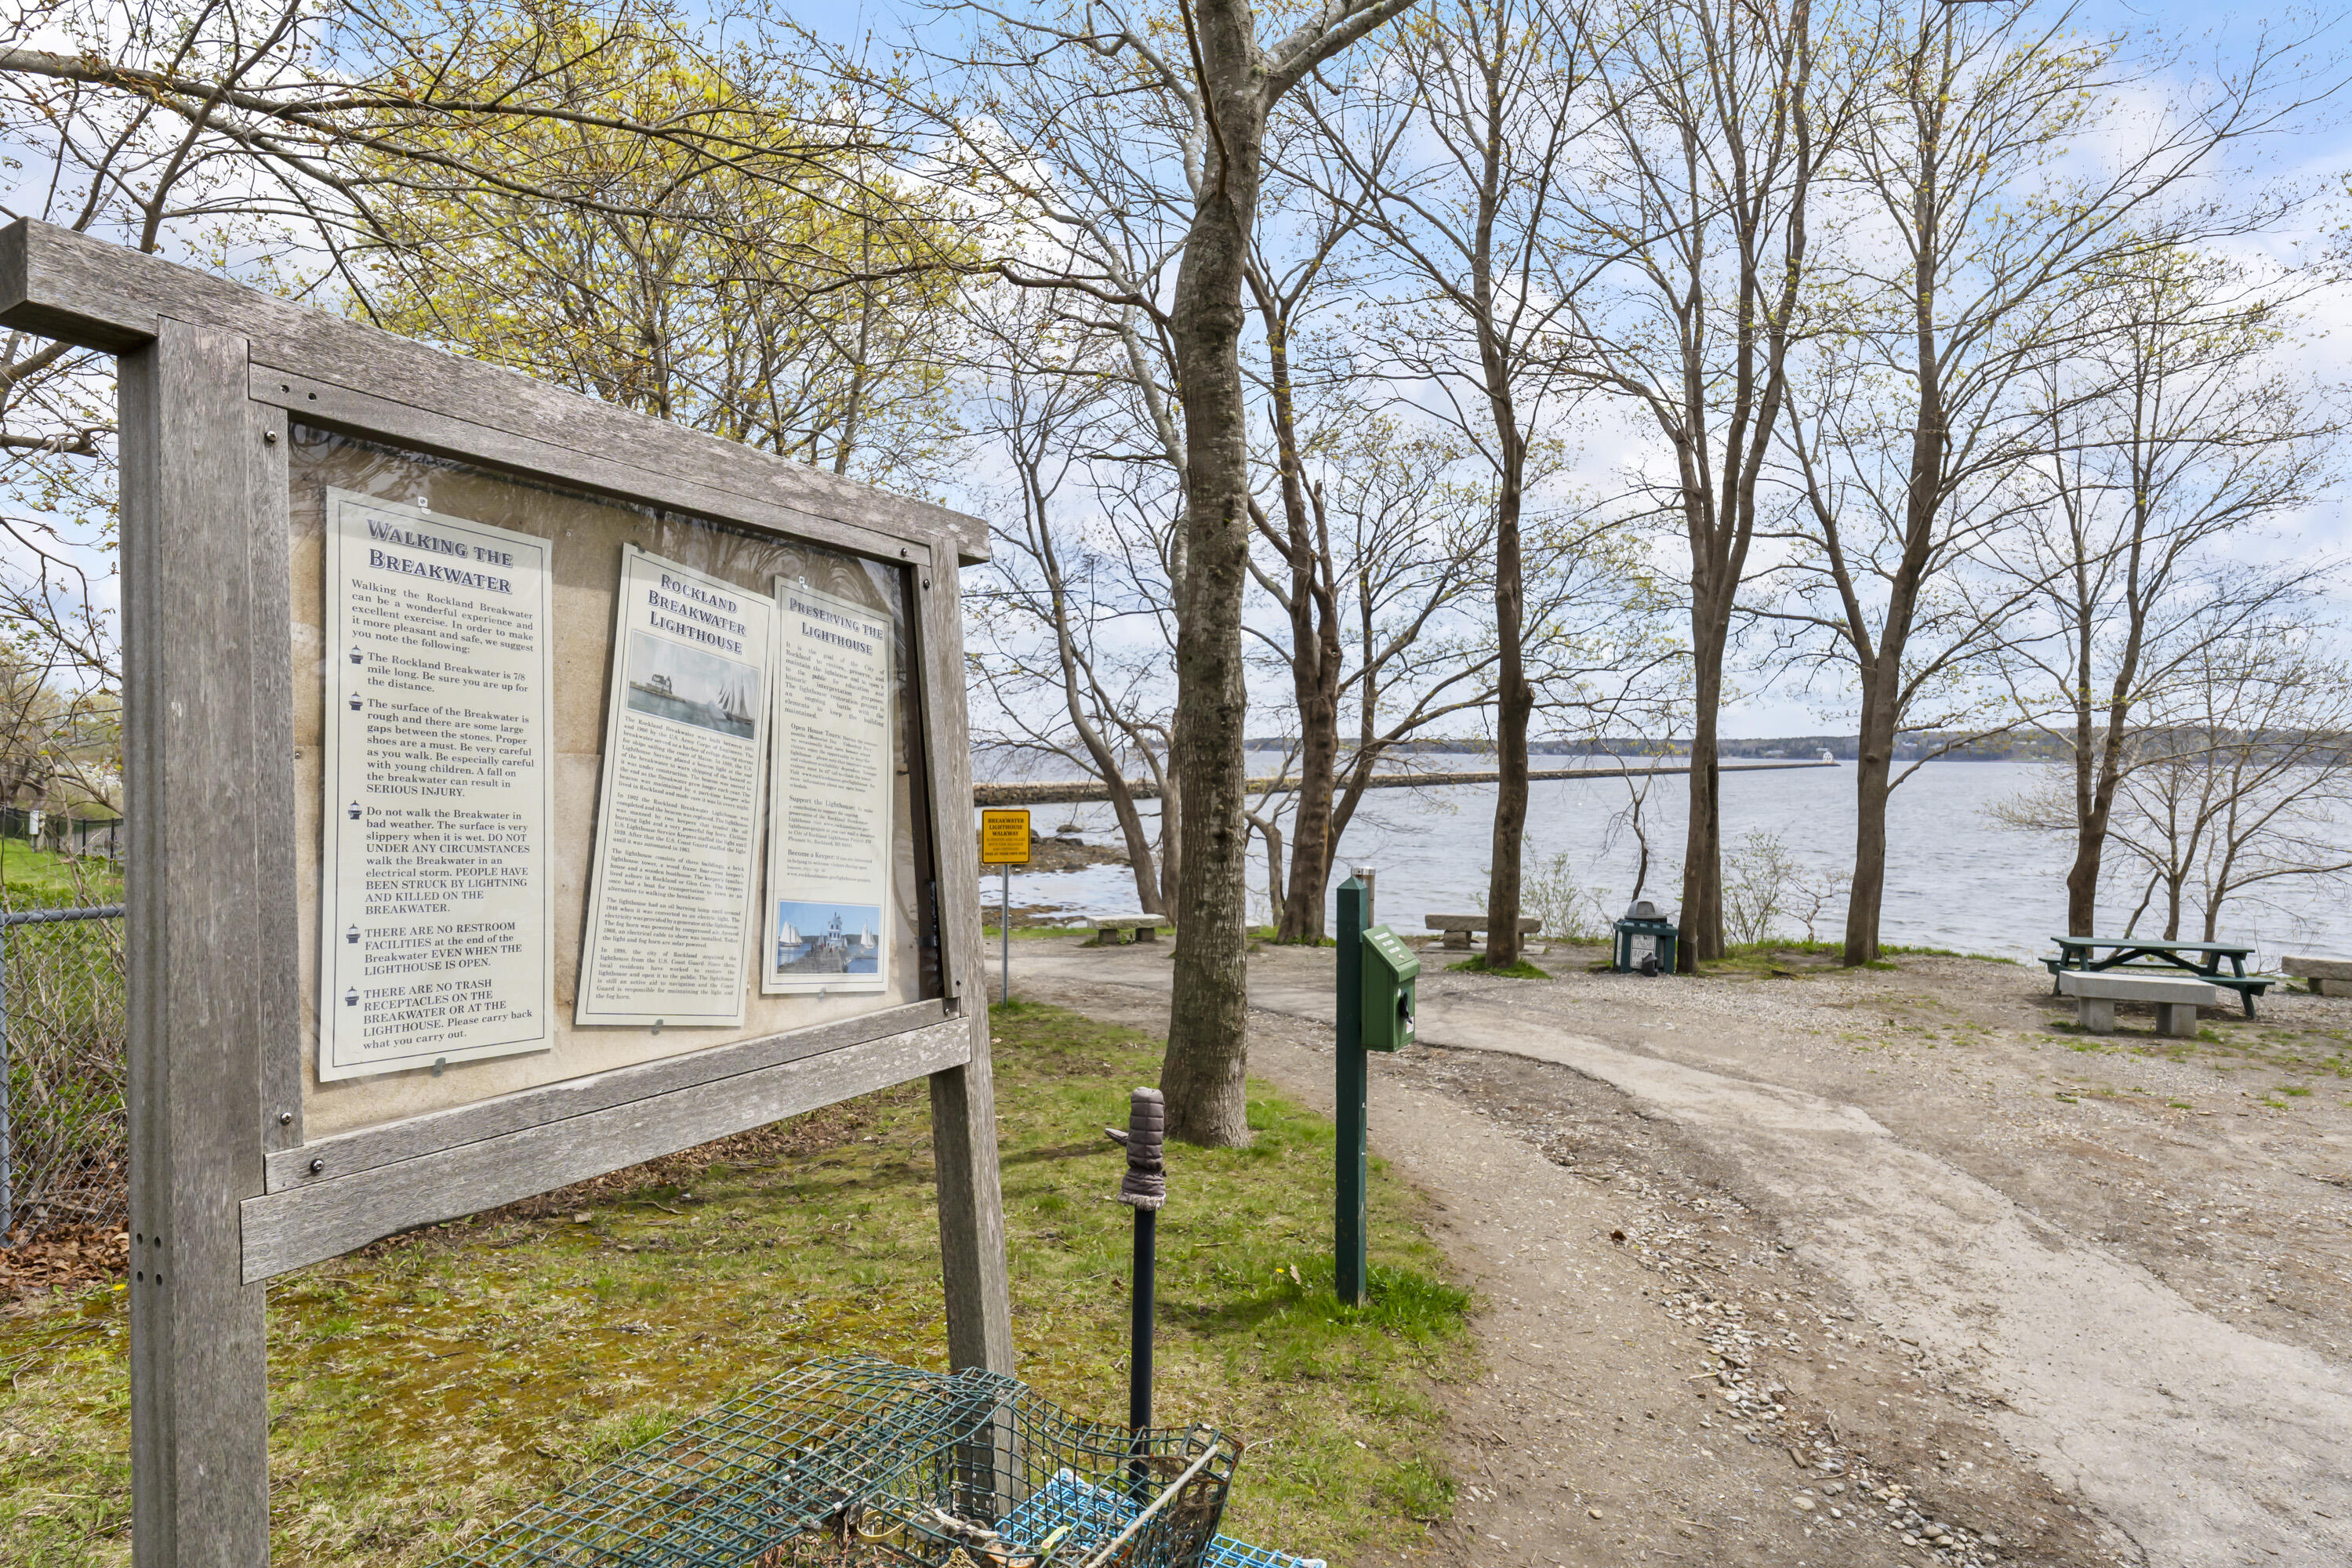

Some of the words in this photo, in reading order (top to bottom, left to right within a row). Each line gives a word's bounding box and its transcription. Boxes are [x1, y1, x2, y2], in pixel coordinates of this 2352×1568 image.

[367, 519, 468, 559] WALKING
[473, 546, 514, 568] THE
[368, 548, 513, 595] BREAKWATER
[351, 579, 397, 597] Walking
[403, 589, 419, 599] the
[426, 593, 474, 609] Rockland
[480, 602, 533, 619] Breakwater
[660, 573, 738, 614] ROCKLAND
[351, 593, 372, 602] can
[376, 594, 390, 606] be
[405, 602, 457, 617] wonderful
[461, 613, 513, 627] experience
[516, 622, 533, 630] and
[648, 589, 746, 637] BREAKWATER
[789, 597, 860, 633] PRESERVING
[862, 623, 883, 641] THE
[351, 605, 400, 619] excellent
[404, 614, 448, 627] exercise.
[452, 619, 463, 630] In
[466, 624, 492, 634] order
[495, 628, 506, 637] to
[508, 631, 533, 641] make
[352, 615, 361, 625] it
[362, 619, 390, 630] more
[394, 622, 437, 637] pleasant
[439, 631, 459, 641] and
[460, 634, 482, 644] safe,
[499, 641, 533, 652] suggest
[649, 610, 742, 655] LIGHTHOUSE
[801, 621, 873, 656] LIGHTHOUSE
[351, 630, 372, 639] you
[375, 633, 398, 642] note
[401, 635, 419, 645] the
[421, 637, 470, 655] following:
[367, 652, 388, 663] The
[391, 655, 441, 670] Rockland
[444, 662, 500, 678] Breakwater
[503, 670, 511, 679] is
[513, 672, 525, 681] 7/8
[367, 665, 391, 675] mile
[394, 666, 419, 681] long.
[422, 670, 435, 681] Be
[438, 675, 460, 684] sure
[463, 678, 480, 687] you
[501, 684, 513, 692] up
[515, 683, 528, 692] for
[367, 676, 385, 687] the
[387, 678, 435, 692] distance.
[790, 722, 806, 731] Open
[807, 725, 824, 735] House
[652, 751, 673, 760] Service
[789, 794, 811, 804] Support
[366, 806, 382, 815] Do
[385, 808, 403, 817] not
[405, 808, 431, 817] walk
[434, 808, 450, 818] the
[453, 809, 510, 819] Breakwater
[513, 811, 521, 820] in
[366, 818, 386, 828] bad
[390, 819, 434, 829] weather.
[436, 820, 456, 829] The
[459, 821, 495, 830] surface
[497, 822, 506, 830] is
[365, 831, 409, 843] slippery
[413, 832, 440, 841] when
[444, 833, 451, 841] it
[454, 833, 463, 841] is
[488, 833, 503, 842] DO
[505, 833, 527, 842] NOT
[366, 843, 408, 853] UNDER
[412, 844, 437, 853] ANY
[439, 844, 530, 853] CIRCUMSTANCES
[787, 848, 810, 858] Become
[365, 855, 393, 866] walk
[395, 855, 412, 865] the
[416, 855, 476, 865] Breakwater
[478, 856, 488, 865] in
[365, 868, 416, 877] electrical
[456, 867, 498, 877] PEOPLE
[500, 867, 528, 876] HAVE
[365, 880, 398, 890] BEEN
[401, 879, 447, 889] STRUCK
[451, 879, 465, 888] BY
[468, 878, 527, 887] LIGHTNING
[365, 892, 392, 902] AND
[395, 891, 440, 902] KILLED
[442, 891, 459, 900] ON
[461, 890, 484, 899] THE
[365, 903, 450, 915] BREAKWATER.
[365, 927, 406, 938] THERE
[409, 925, 434, 935] ARE
[437, 924, 453, 934] NO
[456, 921, 515, 933] RESTROOM
[365, 938, 431, 950] FACILITIES
[447, 936, 463, 946] the
[466, 935, 485, 944] end
[486, 934, 498, 943] of
[499, 933, 514, 942] the
[365, 952, 428, 964] Breakwater
[431, 947, 463, 959] EVEN
[464, 945, 498, 956] WHEN
[500, 944, 522, 953] THE
[364, 960, 442, 976] LIGHTHOUSE
[445, 960, 456, 970] IS
[458, 957, 491, 968] OPEN.
